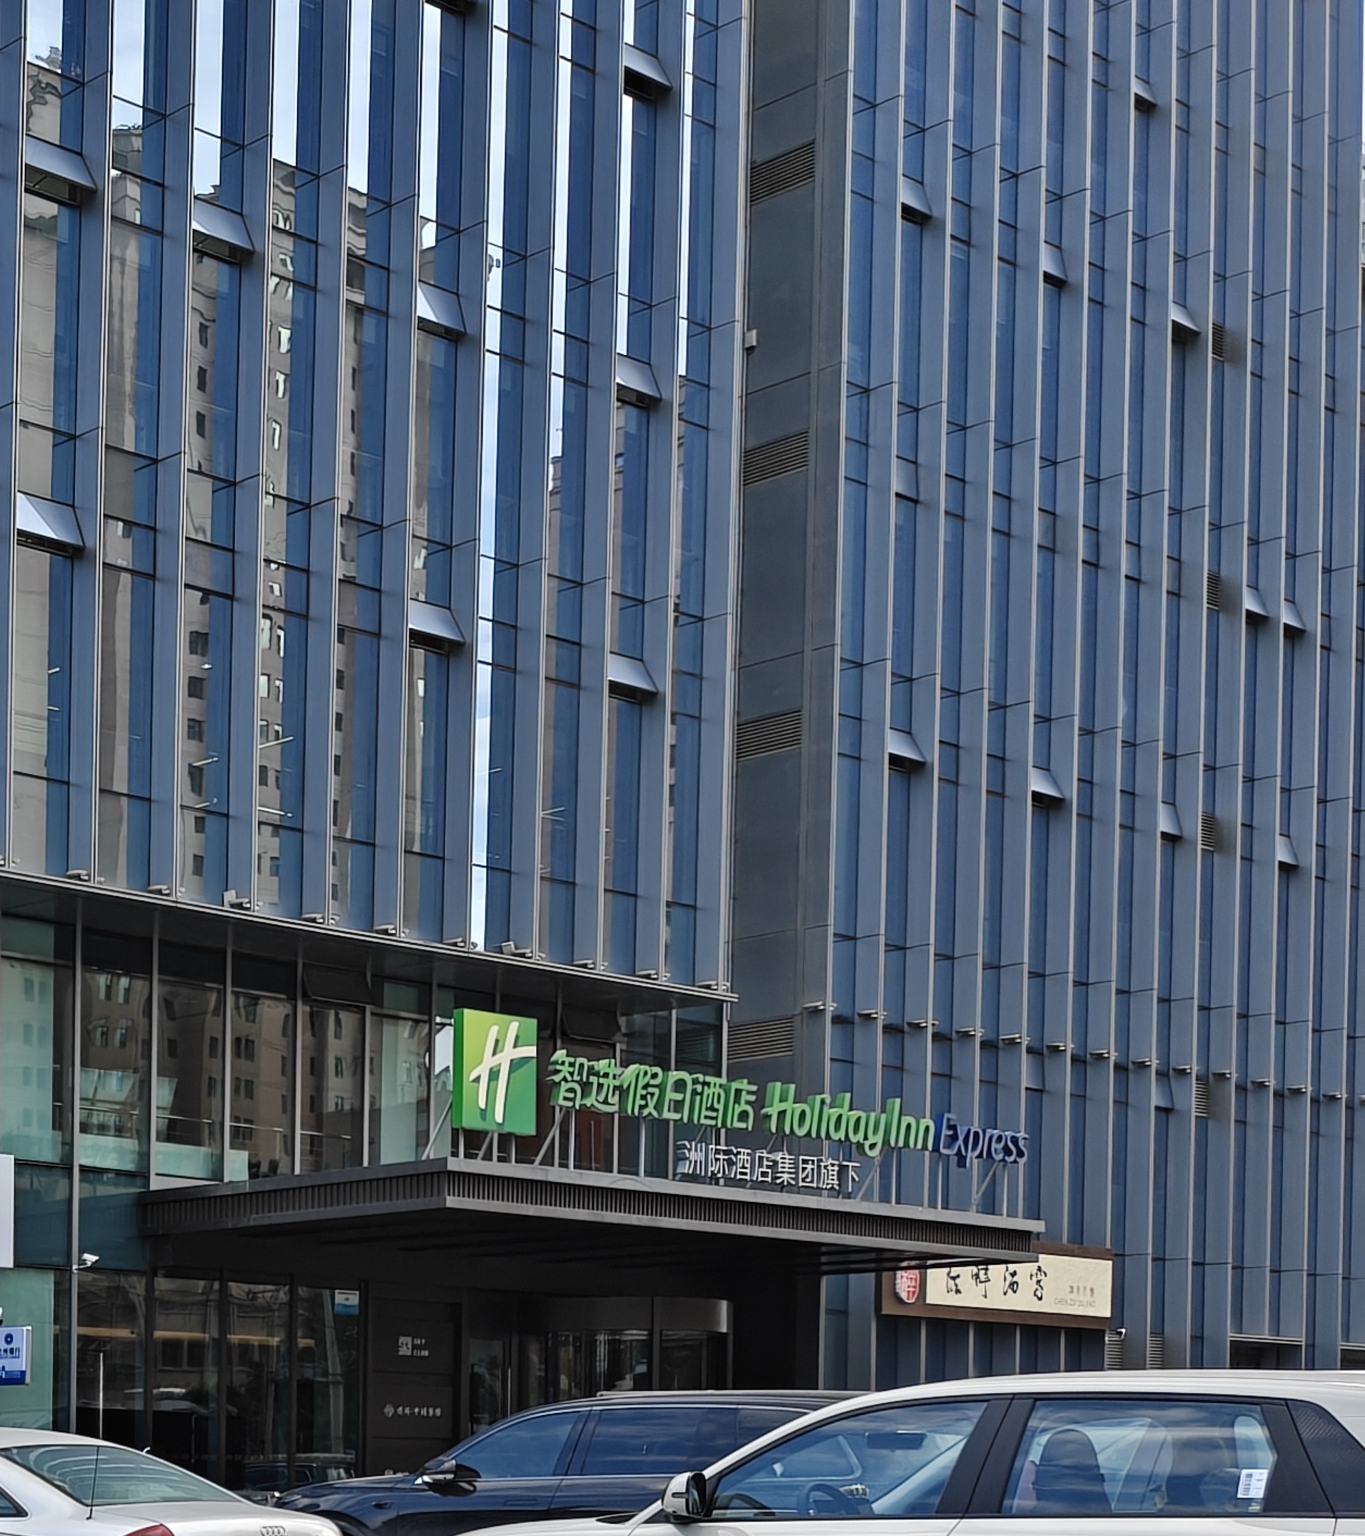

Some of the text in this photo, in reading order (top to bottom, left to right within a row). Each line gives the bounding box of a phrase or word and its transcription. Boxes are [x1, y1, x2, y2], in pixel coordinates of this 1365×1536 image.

[548, 1049, 760, 1132] 智选假日酒店
[760, 1080, 1029, 1169] Holiday Inn Express
[675, 1140, 861, 1194] 洲际酒店集团旗下
